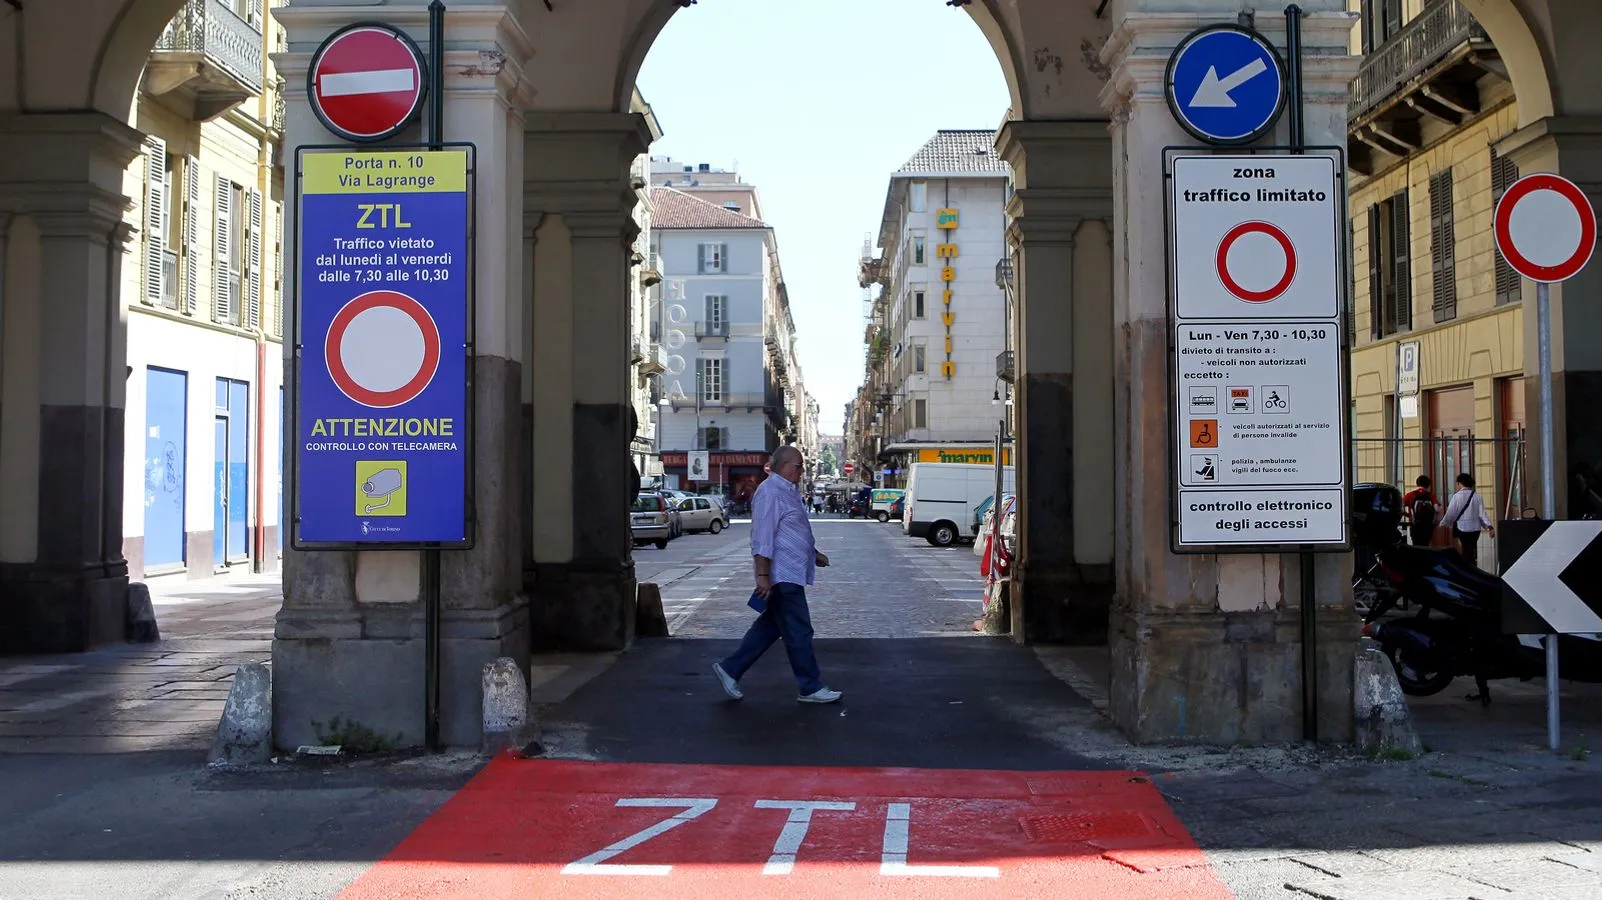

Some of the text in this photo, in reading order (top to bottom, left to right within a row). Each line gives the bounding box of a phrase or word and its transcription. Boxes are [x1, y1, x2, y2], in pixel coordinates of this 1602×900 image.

[345, 156, 424, 169] Porta n. 10
[1233, 168, 1275, 178] zona
[338, 174, 435, 189] Via Lagrange
[1183, 188, 1326, 202] traffico limitato
[356, 203, 412, 229] ZTL
[334, 237, 434, 249] Traffico vietato
[316, 253, 452, 266] dal lunedì al venerdì
[318, 269, 449, 284] dalle 7,30 alle 10,30
[1189, 331, 1212, 340] Lun
[1224, 330, 1248, 340] Ven
[1252, 330, 1279, 342] 7,30
[1291, 330, 1326, 341] 10,30
[1181, 347, 1213, 355] divieto
[1215, 347, 1224, 355] di
[1226, 347, 1262, 355] transito
[1258, 358, 1307, 366] autorizzati
[1184, 371, 1223, 379] eccetto
[311, 418, 454, 437] ATTENZIONE
[306, 442, 457, 451] CONTROLLO CON TELECAMERA
[1190, 500, 1333, 511] controllo elettronico
[1215, 519, 1308, 531] degli accessi
[560, 797, 999, 877] ZTL
